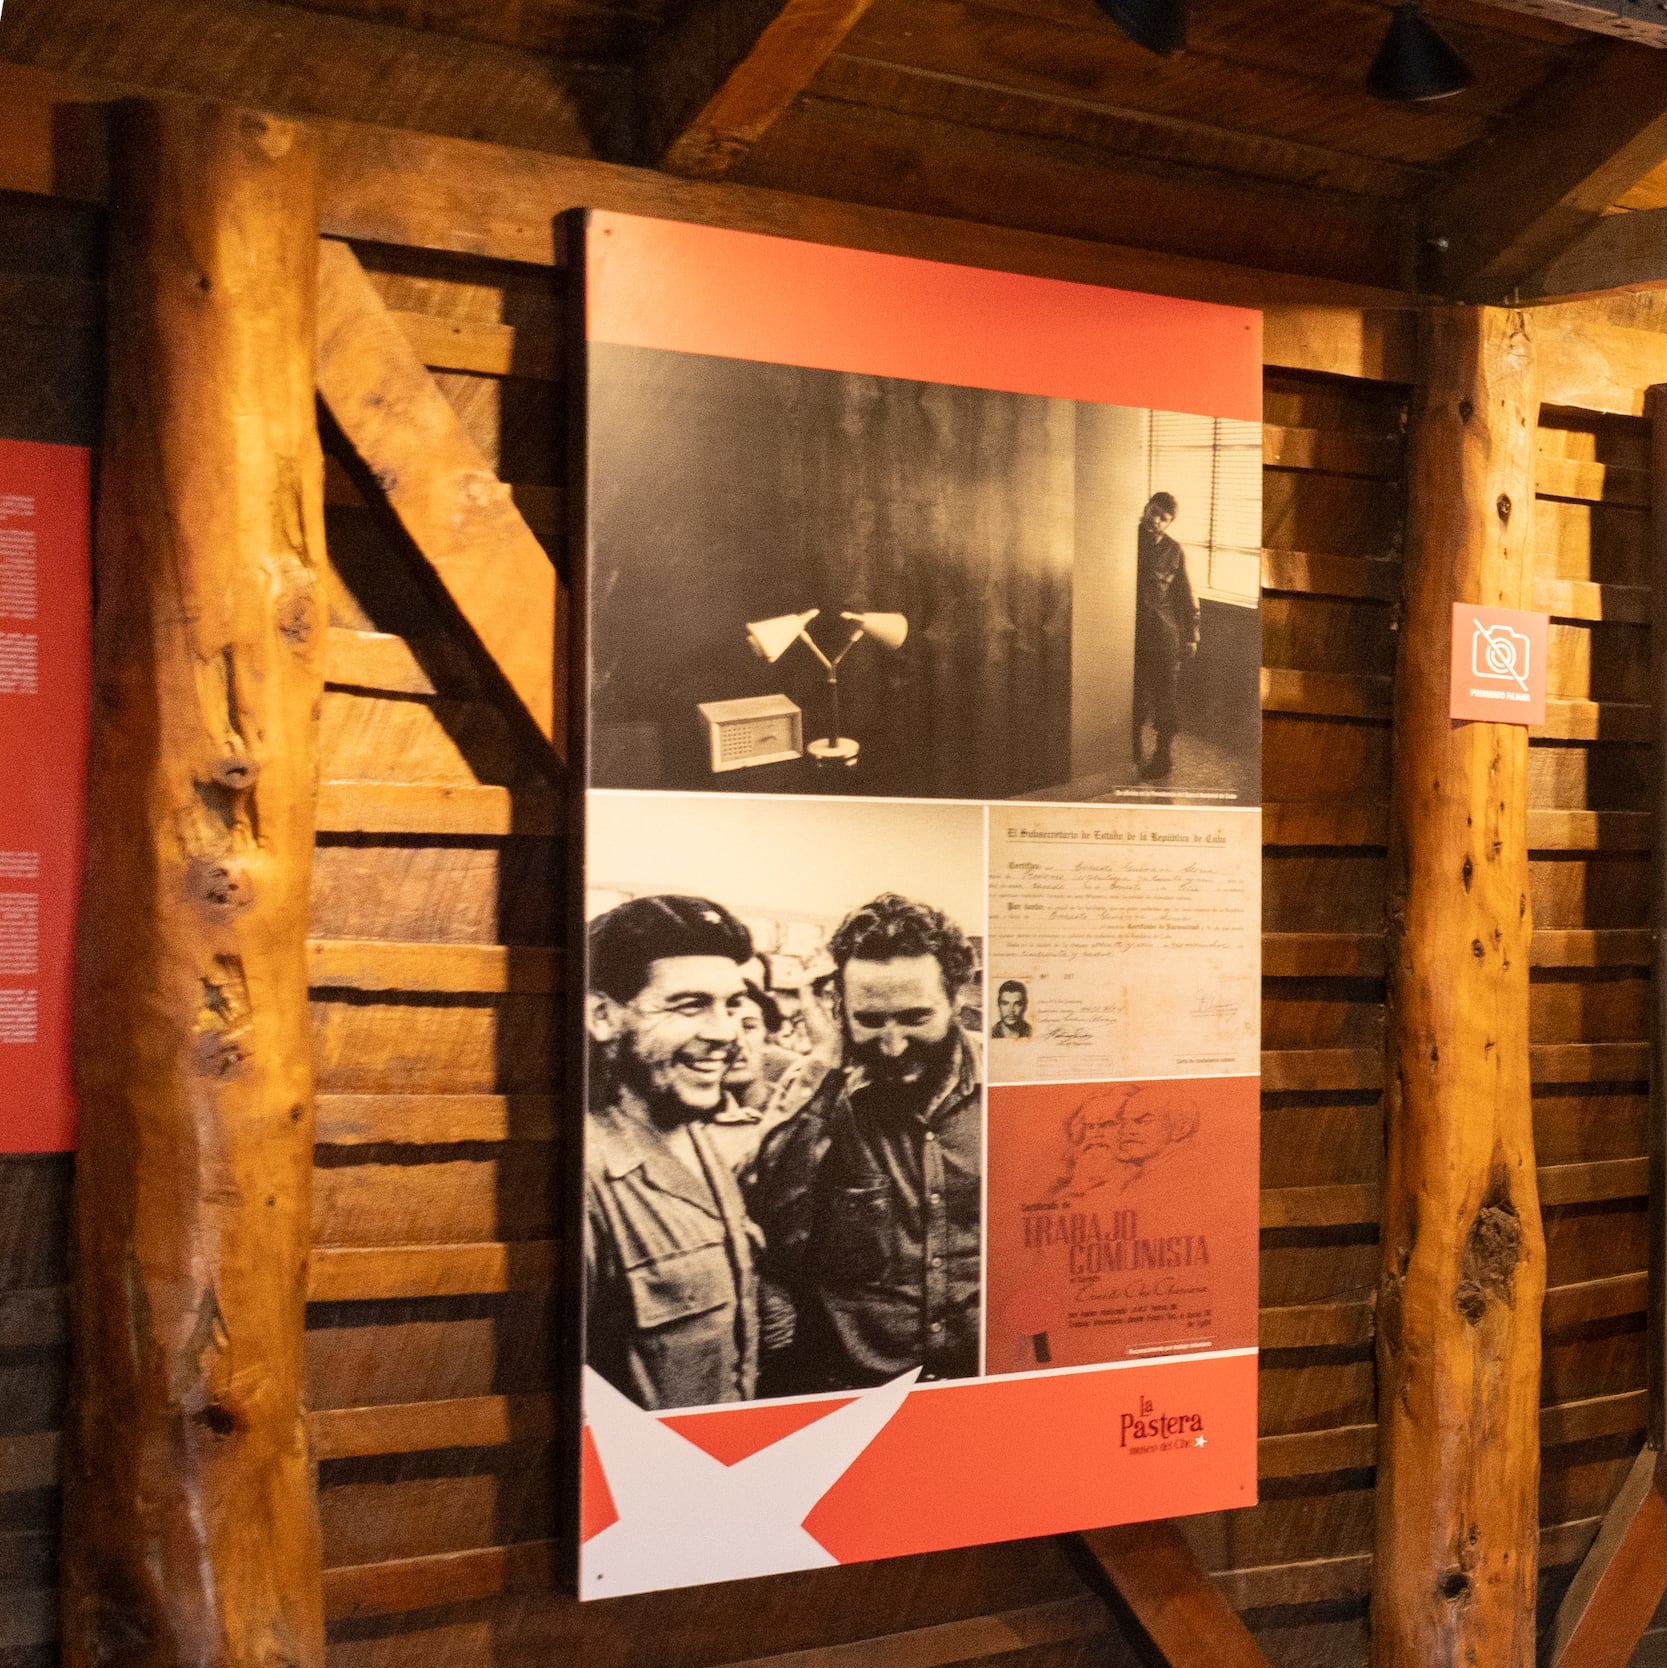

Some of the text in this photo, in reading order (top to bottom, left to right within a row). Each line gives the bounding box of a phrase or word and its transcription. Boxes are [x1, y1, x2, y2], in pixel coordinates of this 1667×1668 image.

[1022, 1209, 1137, 1249] TRABAJO
[1069, 1234, 1211, 1275] COMUNISTA
[1120, 1412, 1204, 1447] Pastera
